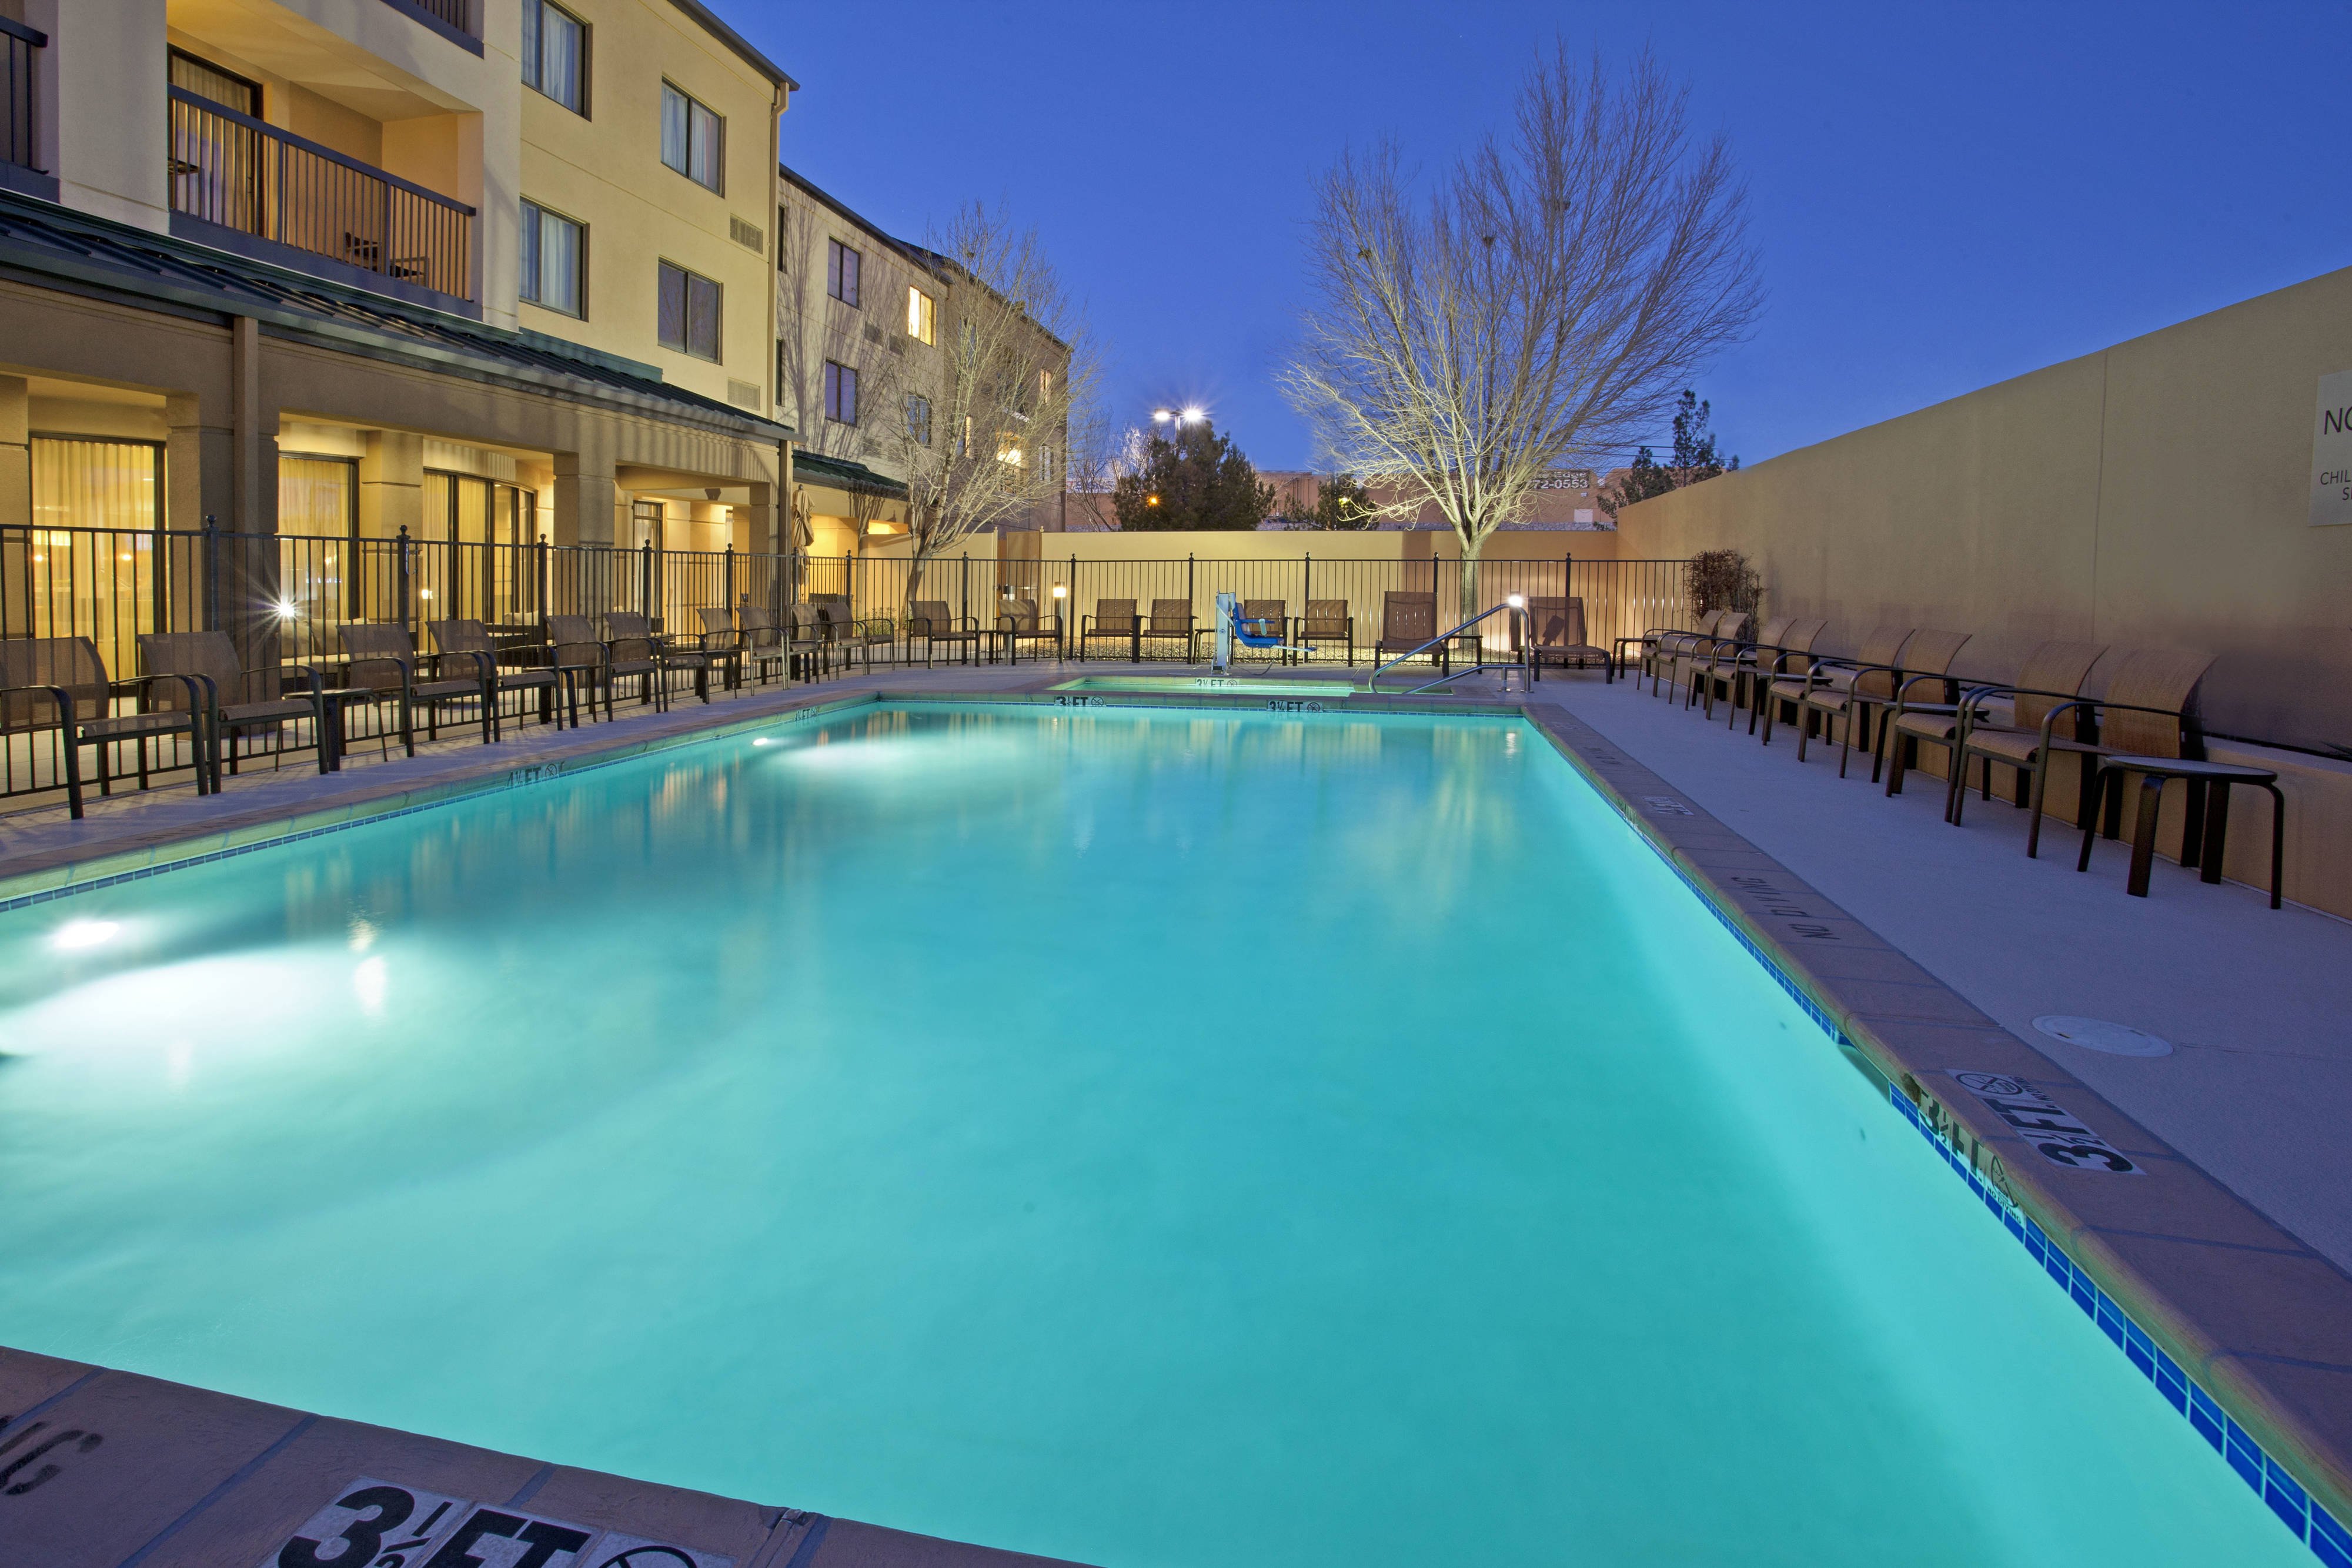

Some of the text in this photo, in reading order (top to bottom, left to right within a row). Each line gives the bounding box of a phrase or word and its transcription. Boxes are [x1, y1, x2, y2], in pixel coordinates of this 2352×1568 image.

[2343, 487, 2352, 500] S
[1073, 697, 1088, 706] FT
[1287, 701, 1303, 712] FT
[1730, 877, 1840, 940] NO DIVING
[1997, 1196, 2022, 1225] DIVING
